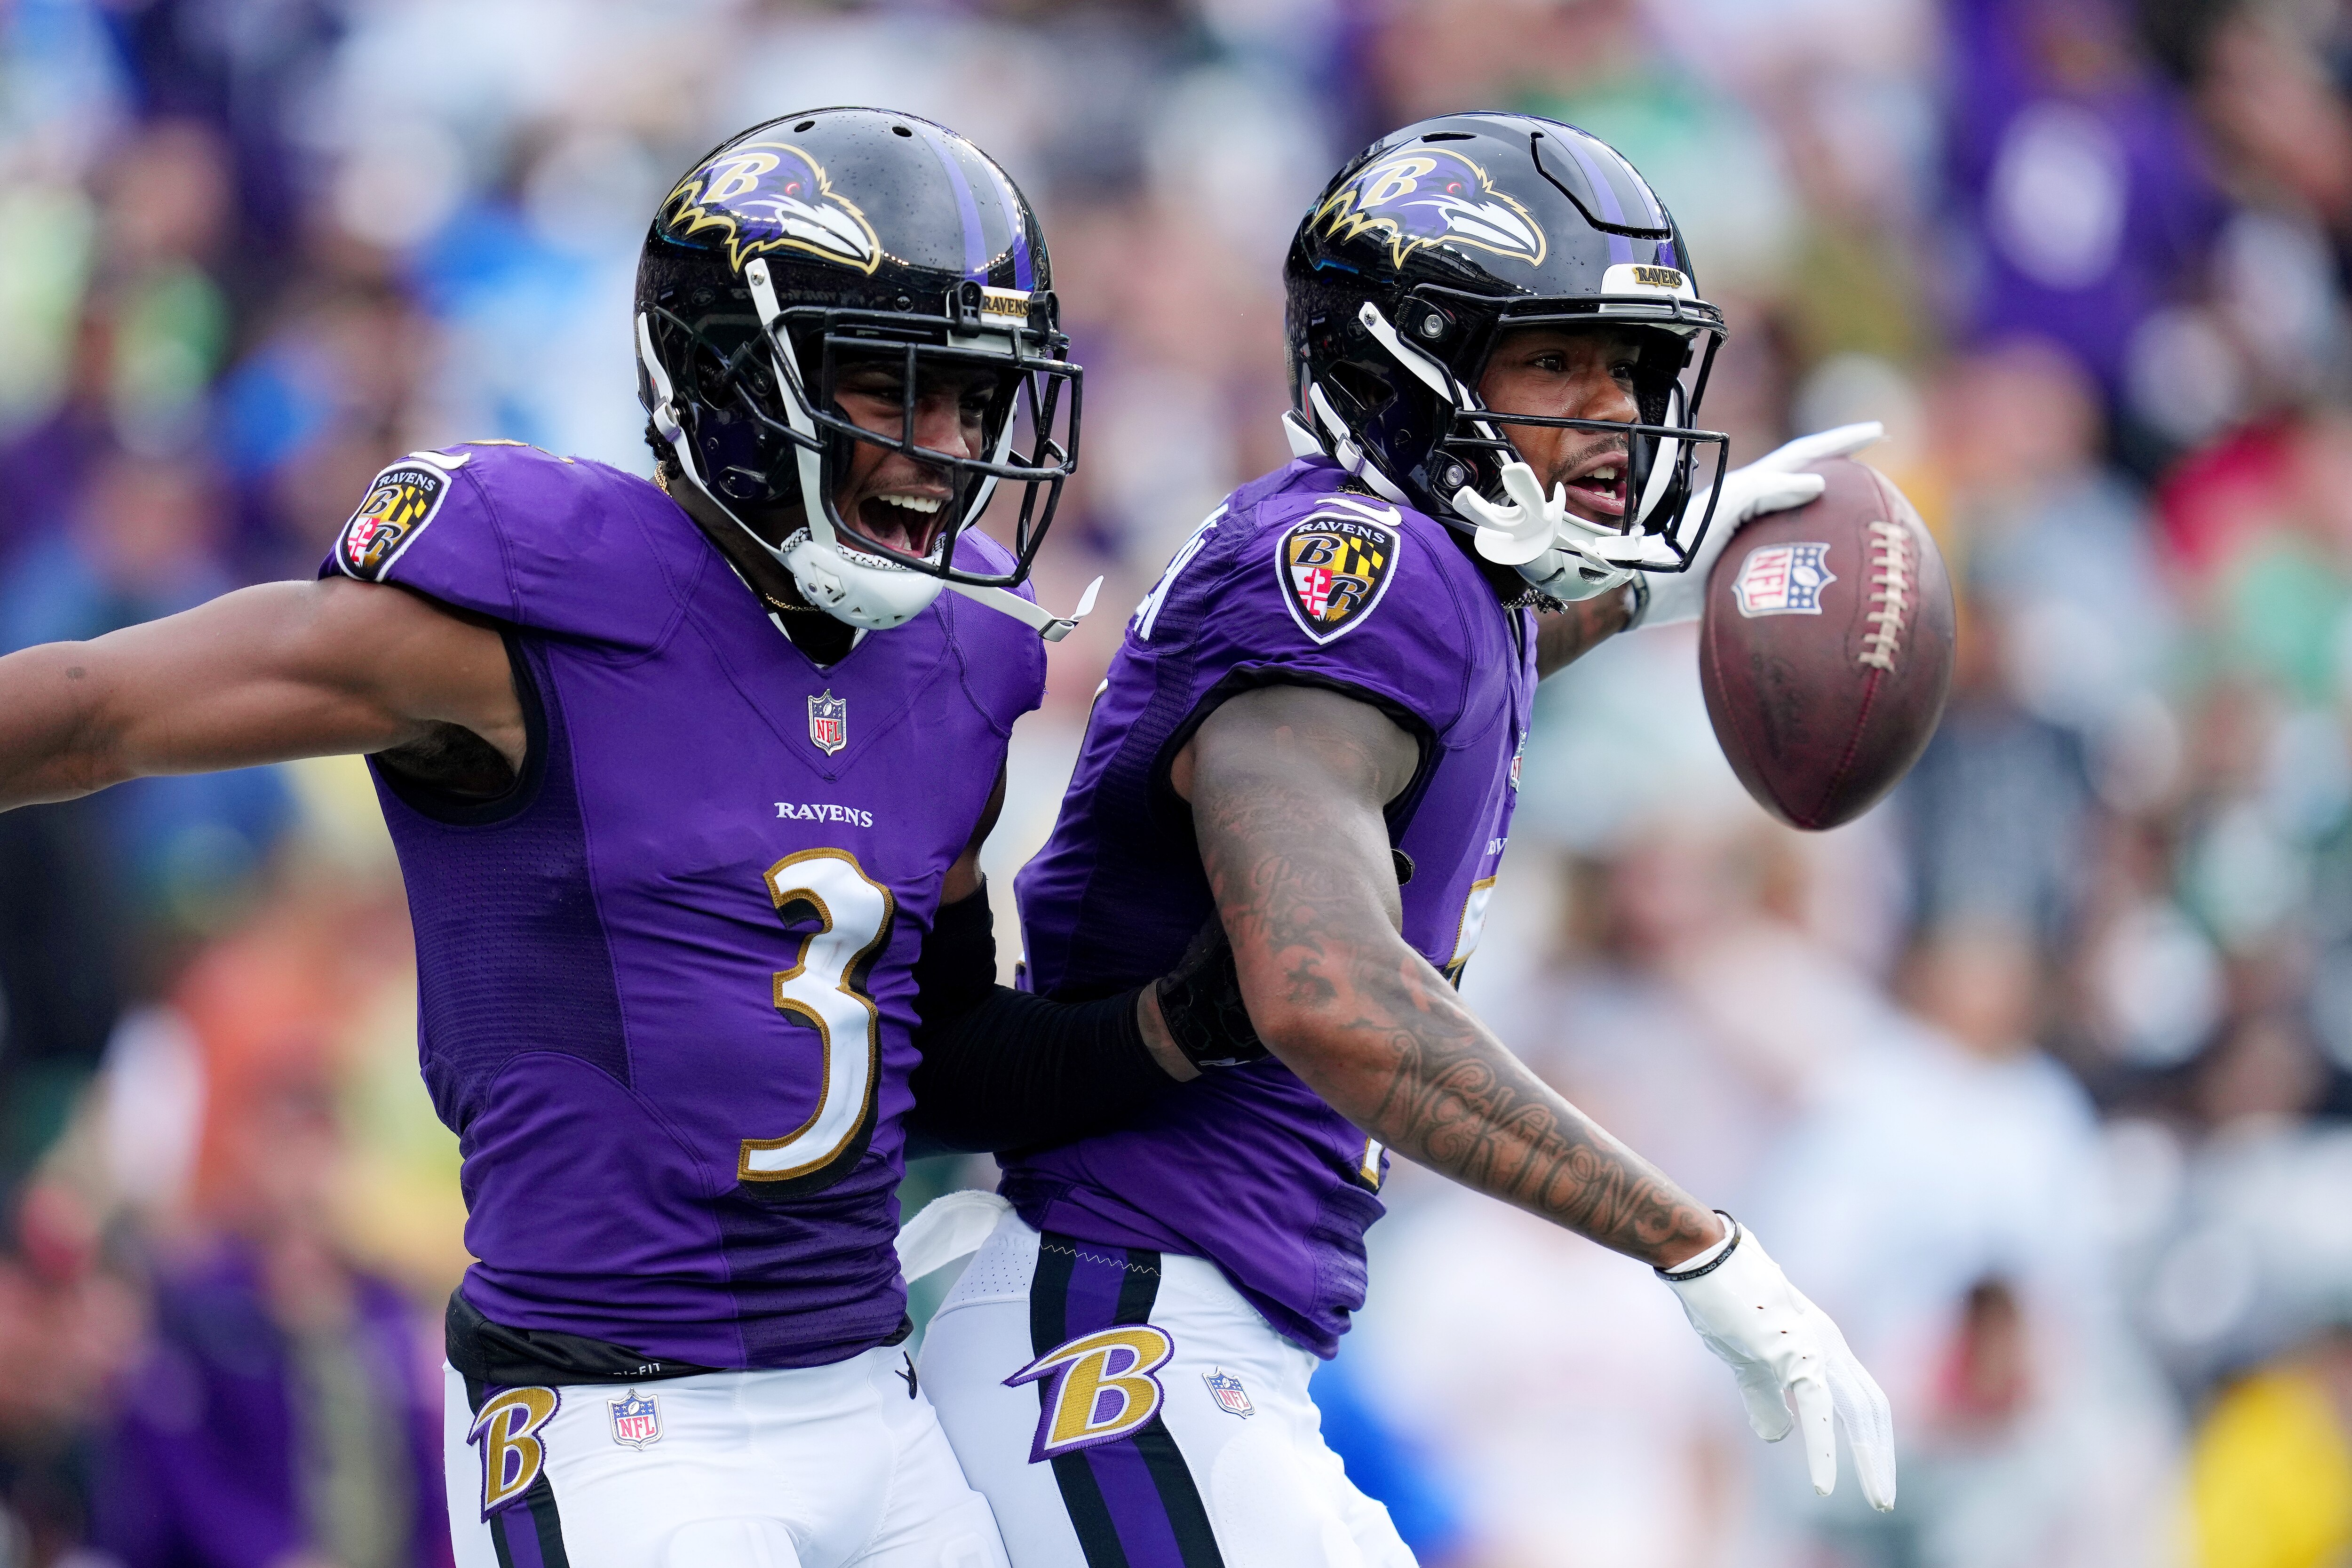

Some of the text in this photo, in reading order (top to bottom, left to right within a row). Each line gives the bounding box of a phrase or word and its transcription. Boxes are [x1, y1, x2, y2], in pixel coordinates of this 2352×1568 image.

[1633, 267, 1683, 287] RAVENS
[982, 295, 1029, 316] RAVENS
[378, 471, 436, 492] RAVENS
[1296, 521, 1386, 544] RAVENS
[1747, 552, 1788, 607] NFL
[816, 719, 842, 744] NFL
[774, 802, 874, 828] RAVENS
[738, 847, 895, 1193] 3
[1006, 1324, 1174, 1459] B
[1217, 1390, 1250, 1409] NFL
[619, 1416, 656, 1439] NFL
[468, 1386, 560, 1519] B
